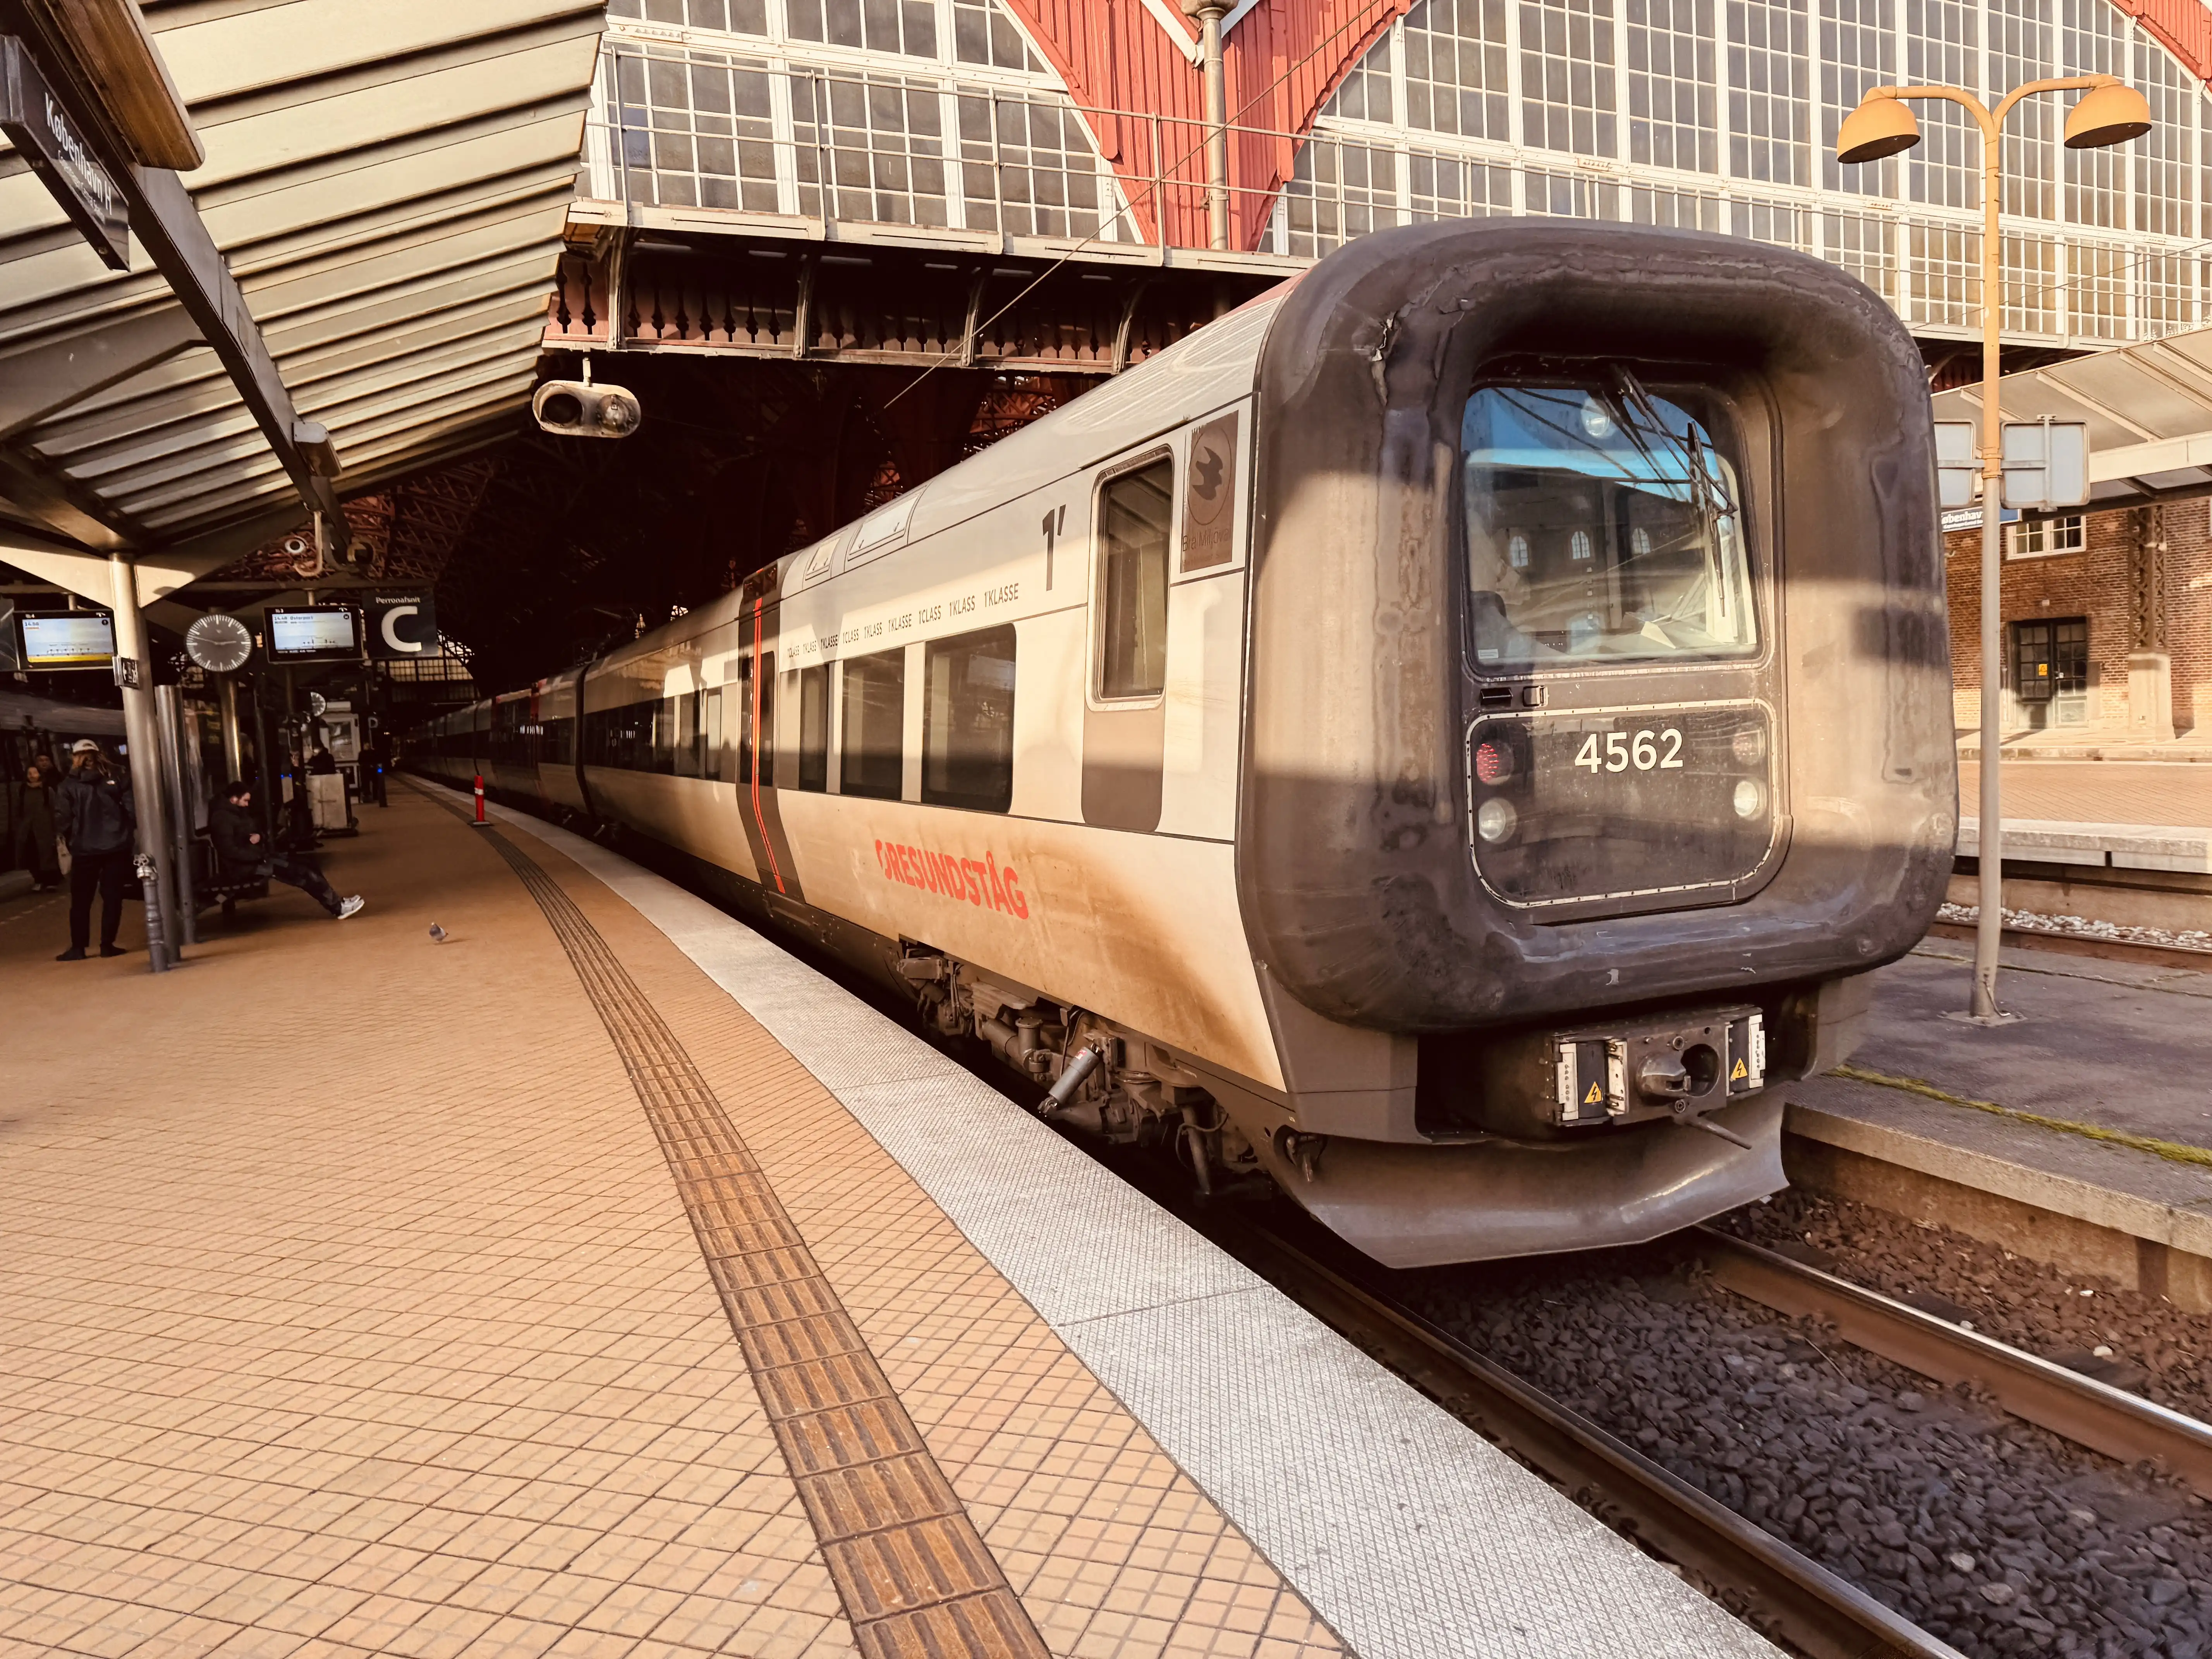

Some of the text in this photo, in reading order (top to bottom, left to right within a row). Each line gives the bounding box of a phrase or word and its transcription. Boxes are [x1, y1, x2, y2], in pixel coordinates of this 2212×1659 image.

[45, 92, 103, 203] København
[104, 180, 112, 215] H
[375, 596, 421, 604] Perronafsnit
[381, 605, 422, 653] C
[1574, 728, 1684, 774] 4562
[875, 839, 1029, 920] ØRESUNDSTÅG
